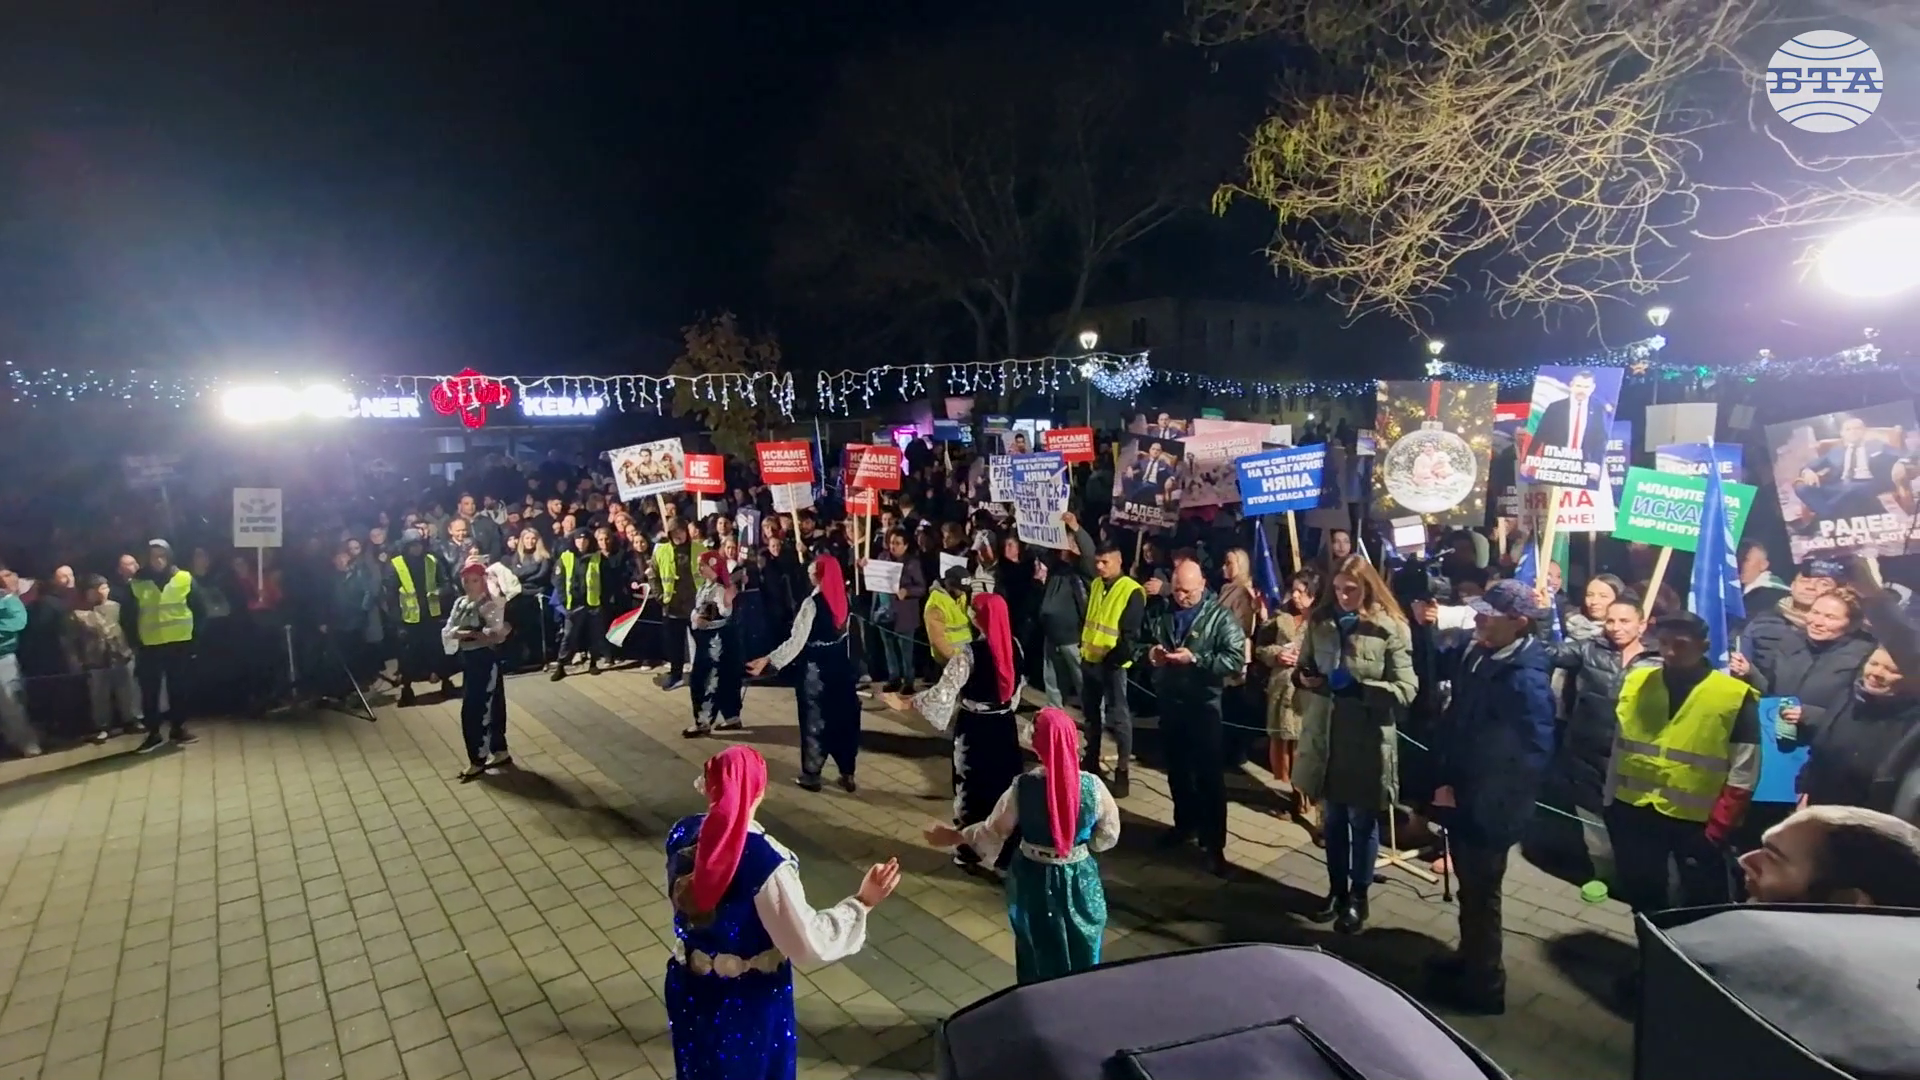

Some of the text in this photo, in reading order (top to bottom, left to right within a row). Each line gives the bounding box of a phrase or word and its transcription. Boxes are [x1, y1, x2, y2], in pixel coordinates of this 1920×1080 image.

[524, 396, 604, 416] KEBAP
[1048, 433, 1090, 445] ИСКАМЕ
[761, 448, 807, 460] ИСКАМЕ
[850, 452, 897, 465] ИСКАМЕ
[690, 459, 710, 478] НЕ
[1247, 459, 1325, 478] НА БЪЛГАРИЯ!
[1024, 470, 1051, 483] НЯМА
[1261, 472, 1314, 493] НЯМА
[1637, 481, 1705, 503] МЛАДИТЕ
[1047, 498, 1060, 512] НЕ
[1247, 495, 1275, 505] ВТОРА
[1627, 516, 1656, 529] МИР
